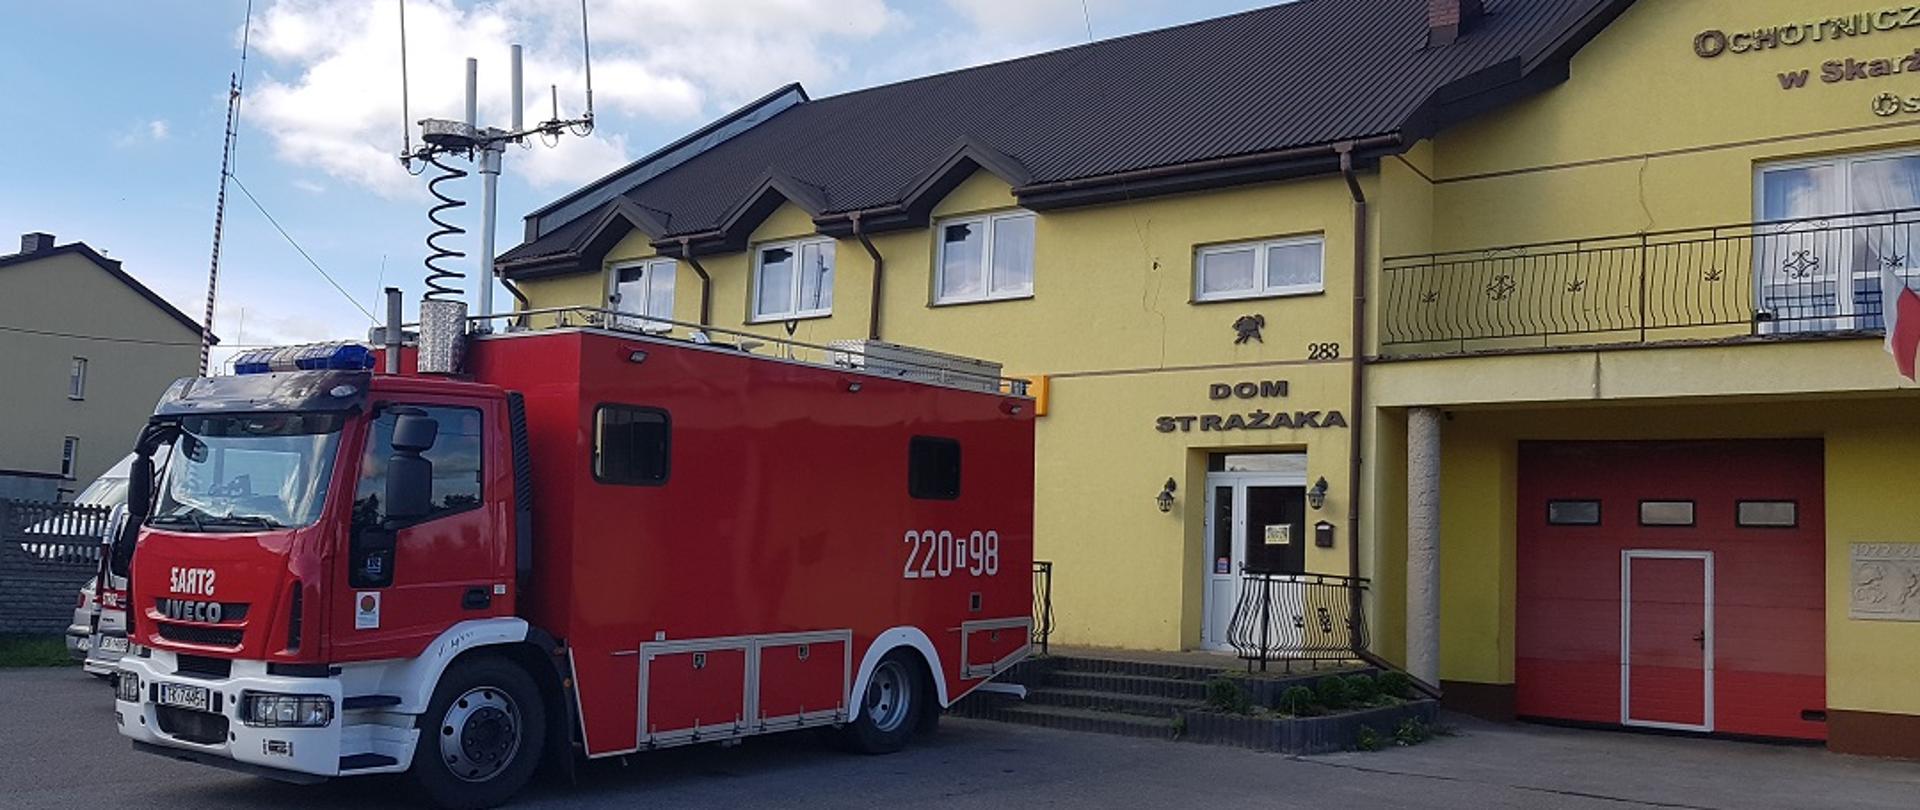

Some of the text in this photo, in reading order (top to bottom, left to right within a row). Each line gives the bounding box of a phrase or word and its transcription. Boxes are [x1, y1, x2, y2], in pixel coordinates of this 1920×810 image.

[1776, 69, 1810, 90] w
[1308, 343, 1340, 360] 283
[1209, 380, 1289, 400] DOM
[1156, 409, 1349, 433] STRAŻAKA
[165, 598, 222, 623] IVECO
